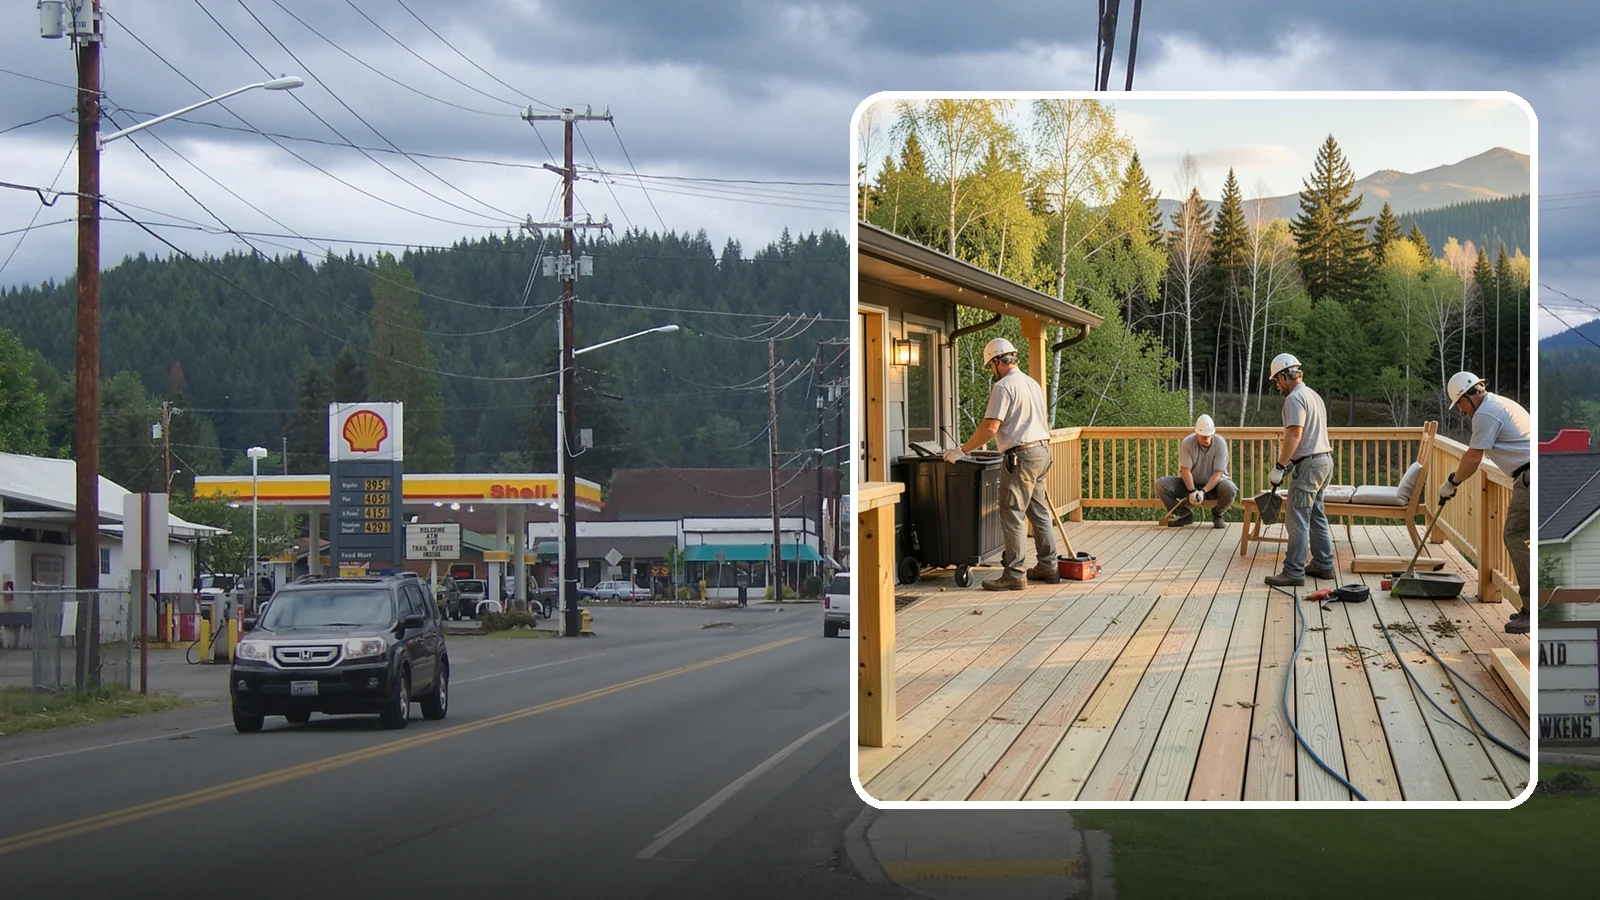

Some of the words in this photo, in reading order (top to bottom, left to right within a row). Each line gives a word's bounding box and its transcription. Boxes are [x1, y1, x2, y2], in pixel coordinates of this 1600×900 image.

[366, 480, 383, 490] 395
[490, 484, 547, 499] Shell
[366, 494, 383, 504] 405
[366, 508, 383, 518] 415
[366, 522, 383, 533] 429
[1538, 642, 1566, 666] AID
